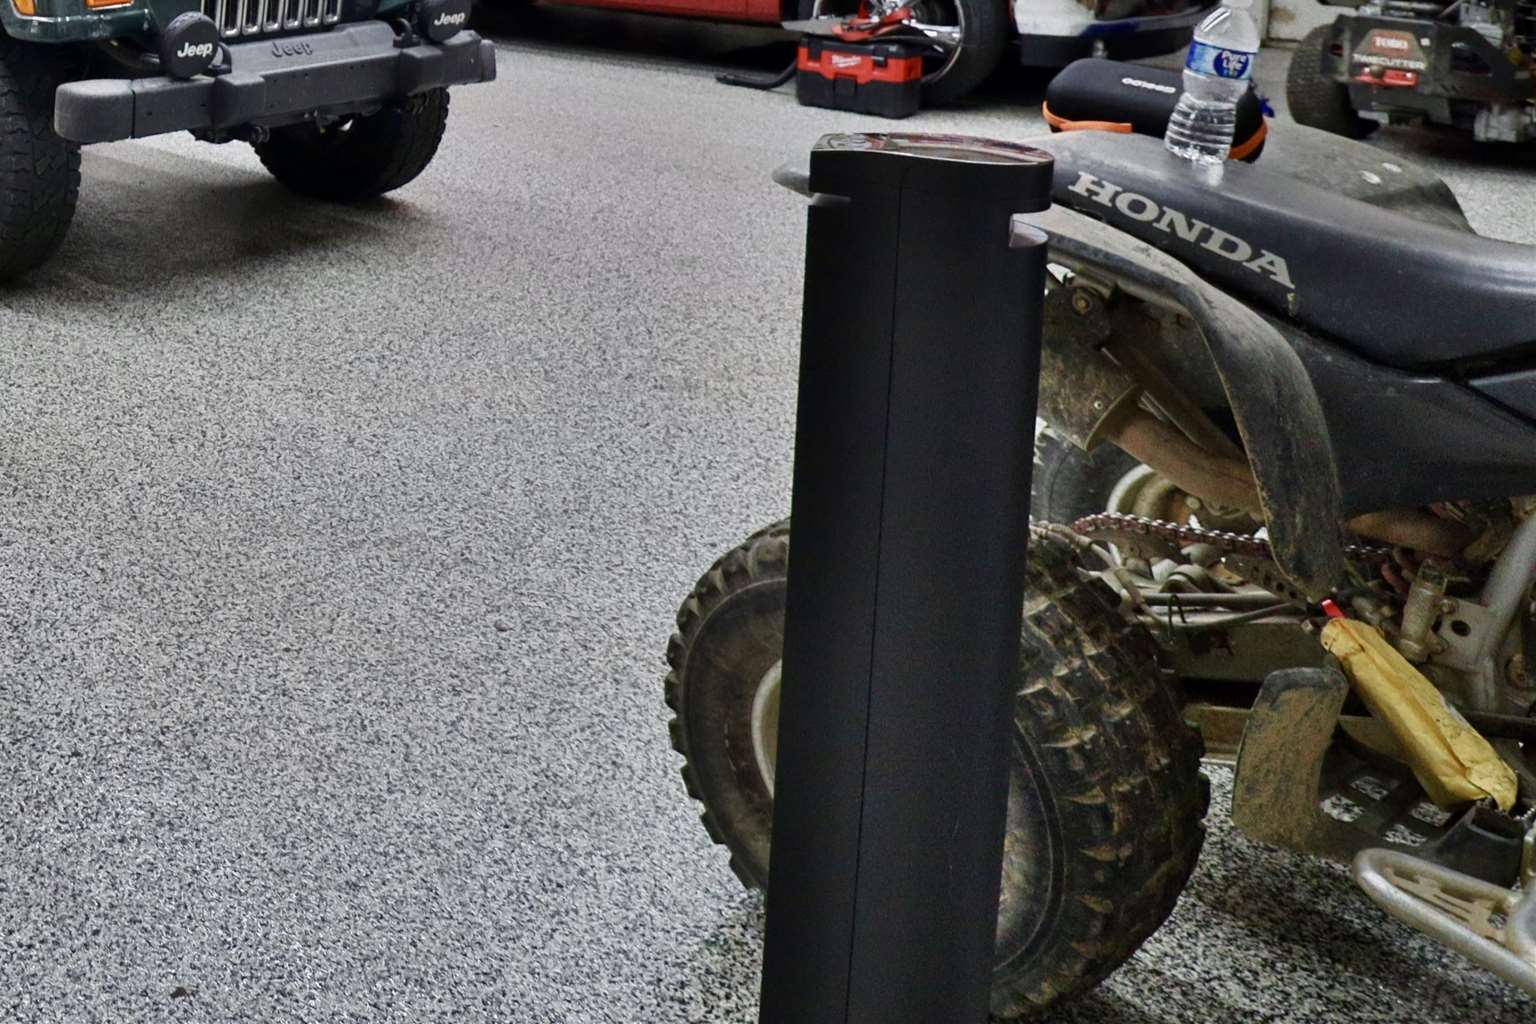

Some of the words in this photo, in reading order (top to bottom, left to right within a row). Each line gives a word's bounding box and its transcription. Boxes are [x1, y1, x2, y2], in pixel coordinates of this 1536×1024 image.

[434, 11, 465, 26] Jeep
[177, 41, 213, 58] Jeep
[271, 41, 314, 58] Jeep
[1067, 171, 1296, 290] HONDA
